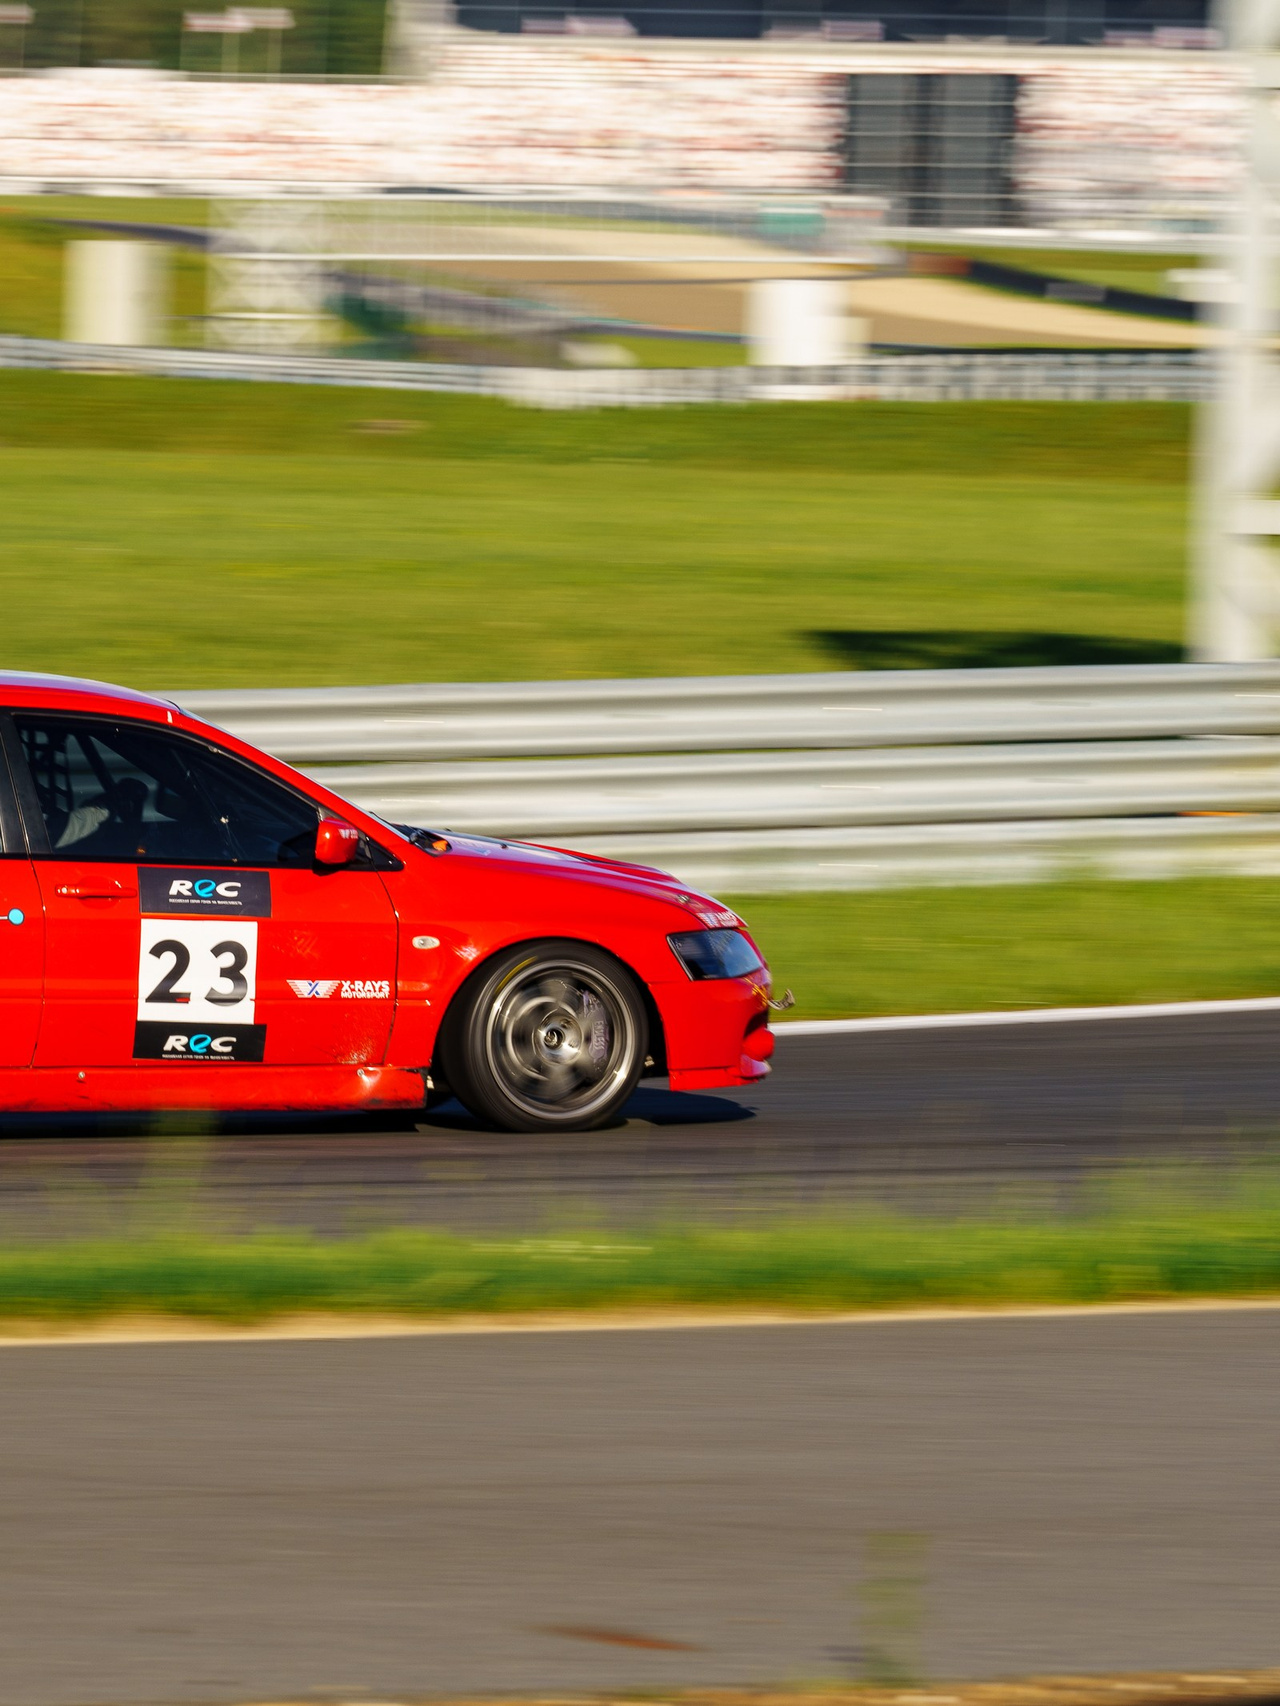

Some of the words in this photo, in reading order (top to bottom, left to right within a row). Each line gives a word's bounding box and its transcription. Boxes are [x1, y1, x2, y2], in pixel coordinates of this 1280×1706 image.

[145, 939, 248, 1007] 23
[341, 980, 390, 992] X-RAYS
[341, 991, 390, 999] MOTORSPORT
